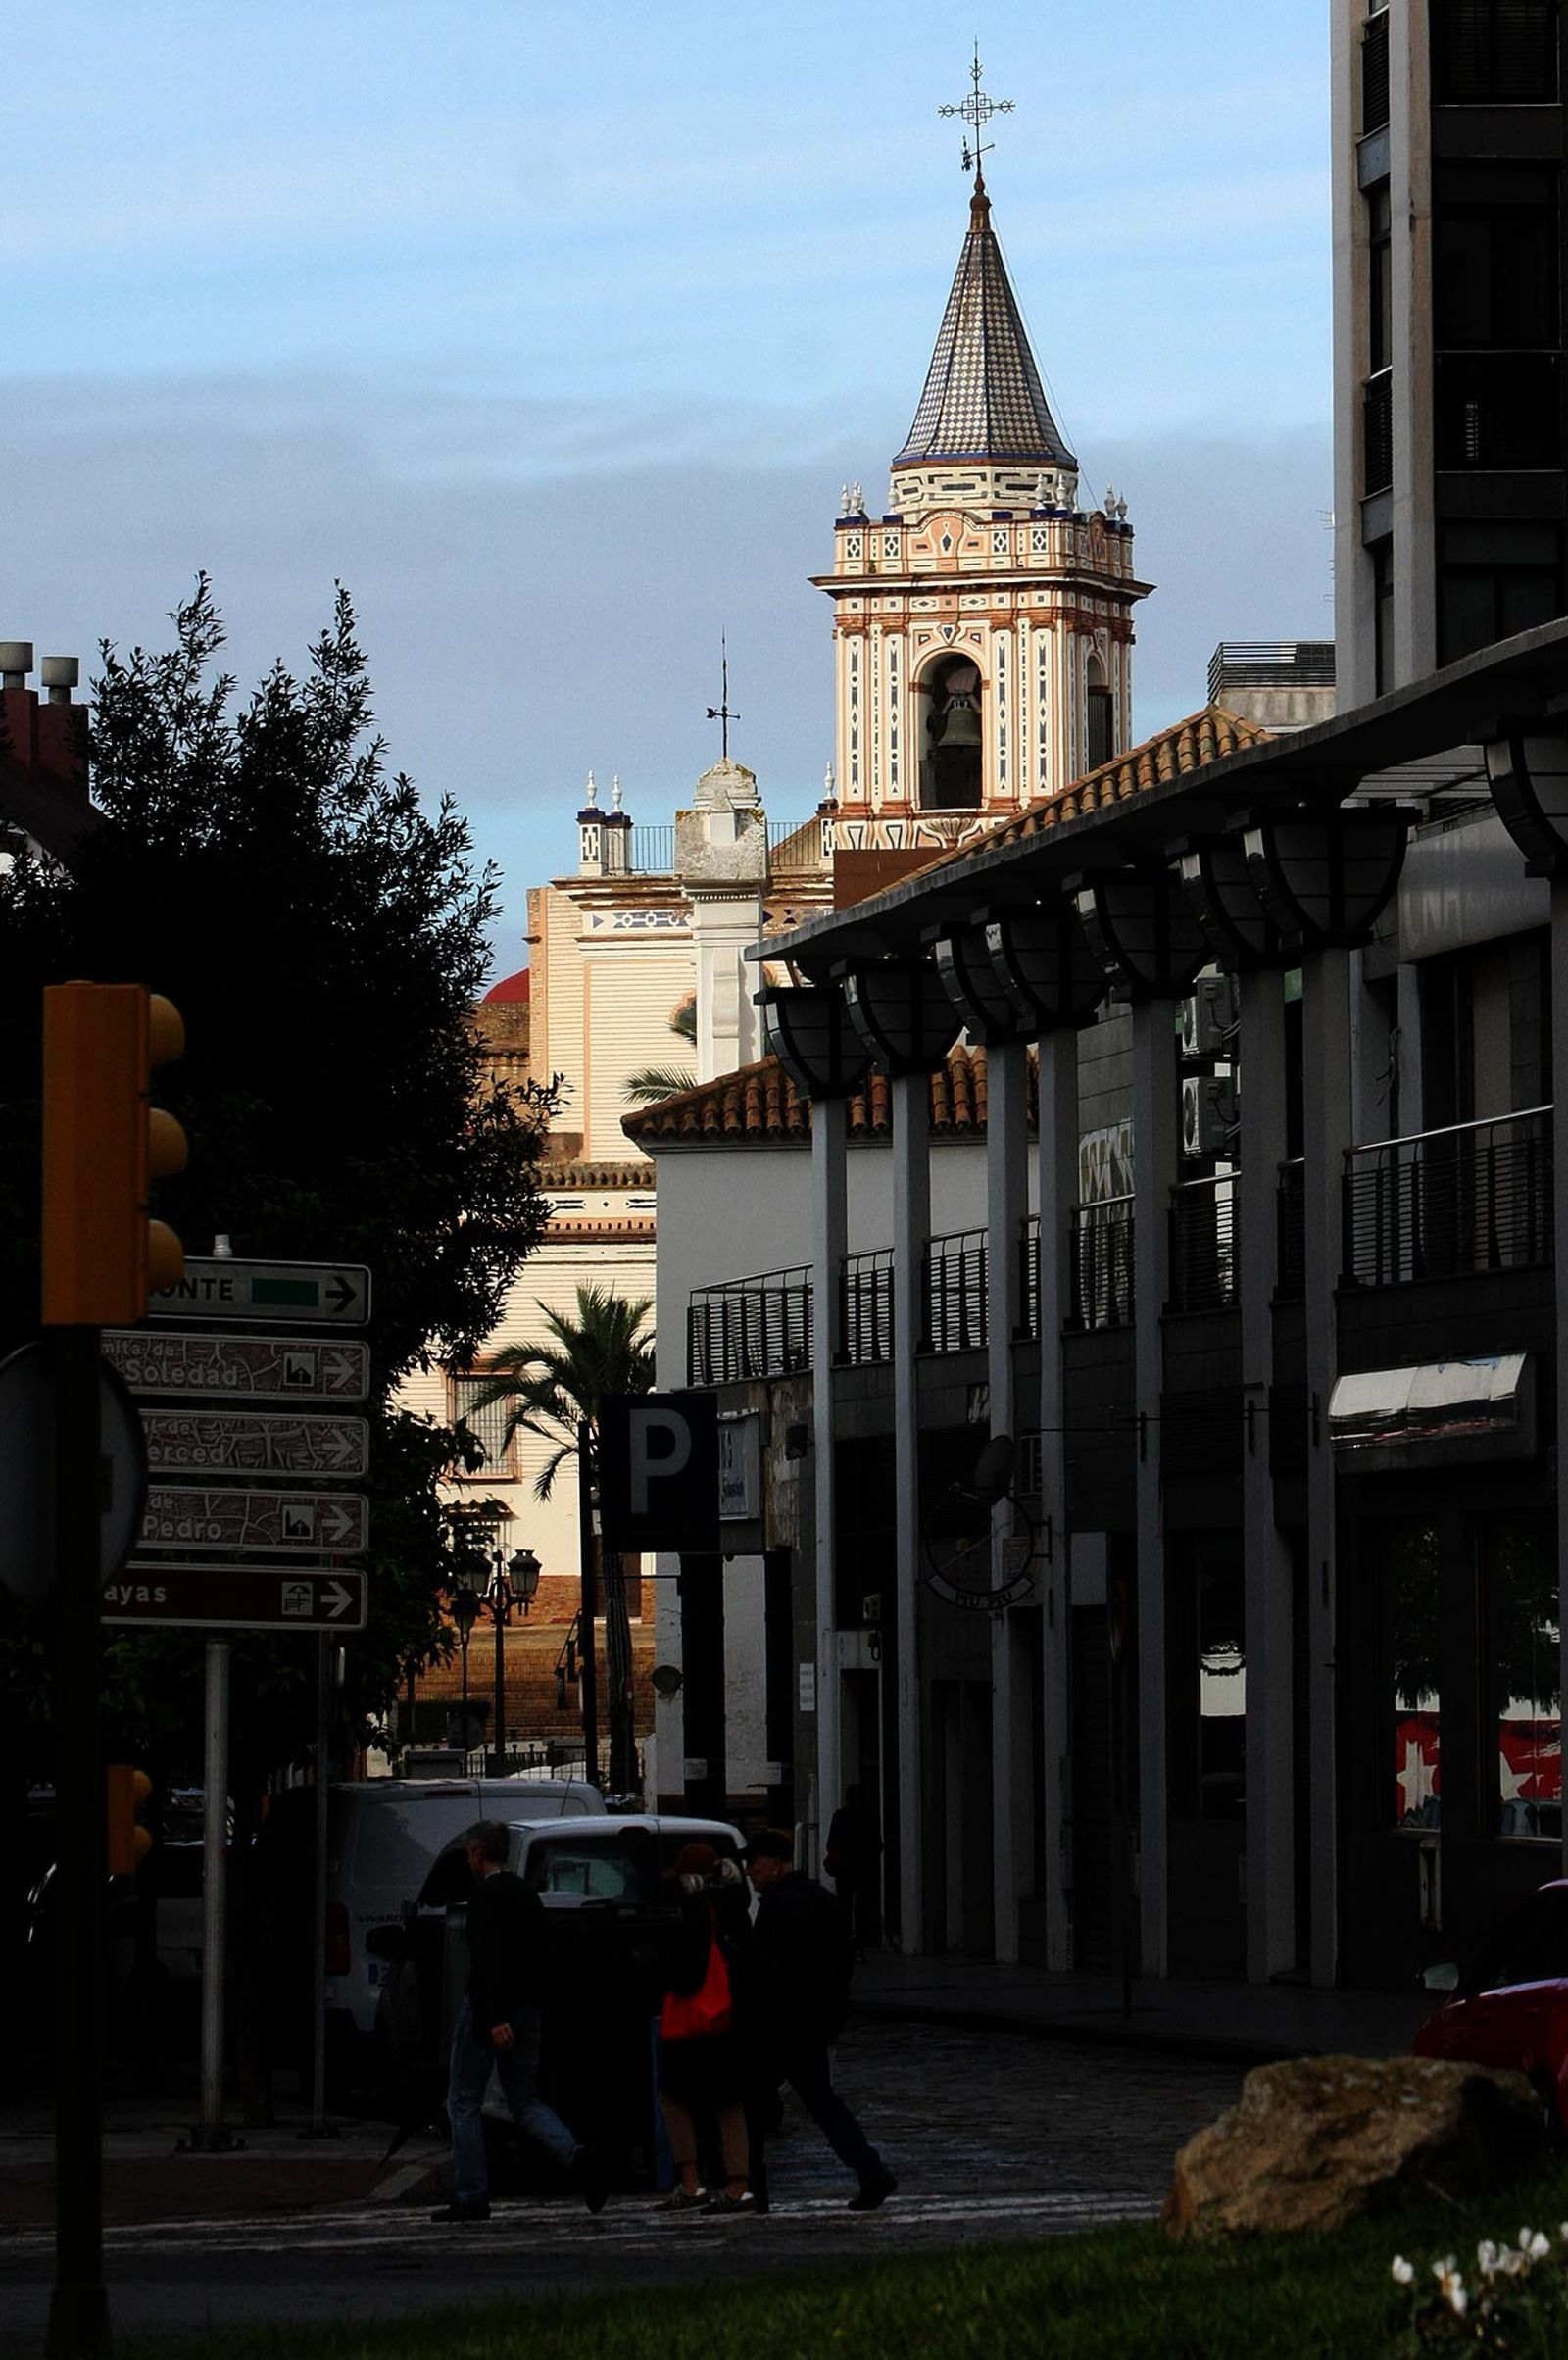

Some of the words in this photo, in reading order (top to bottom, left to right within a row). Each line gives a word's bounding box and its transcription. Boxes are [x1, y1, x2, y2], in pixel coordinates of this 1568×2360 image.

[152, 1343, 174, 1356] de
[124, 1359, 238, 1386] Soledad
[168, 1420, 191, 1435] de
[629, 1408, 692, 1514] P
[150, 1494, 173, 1508] de
[142, 1515, 221, 1539] Pedro
[103, 1584, 168, 1606] ayas
